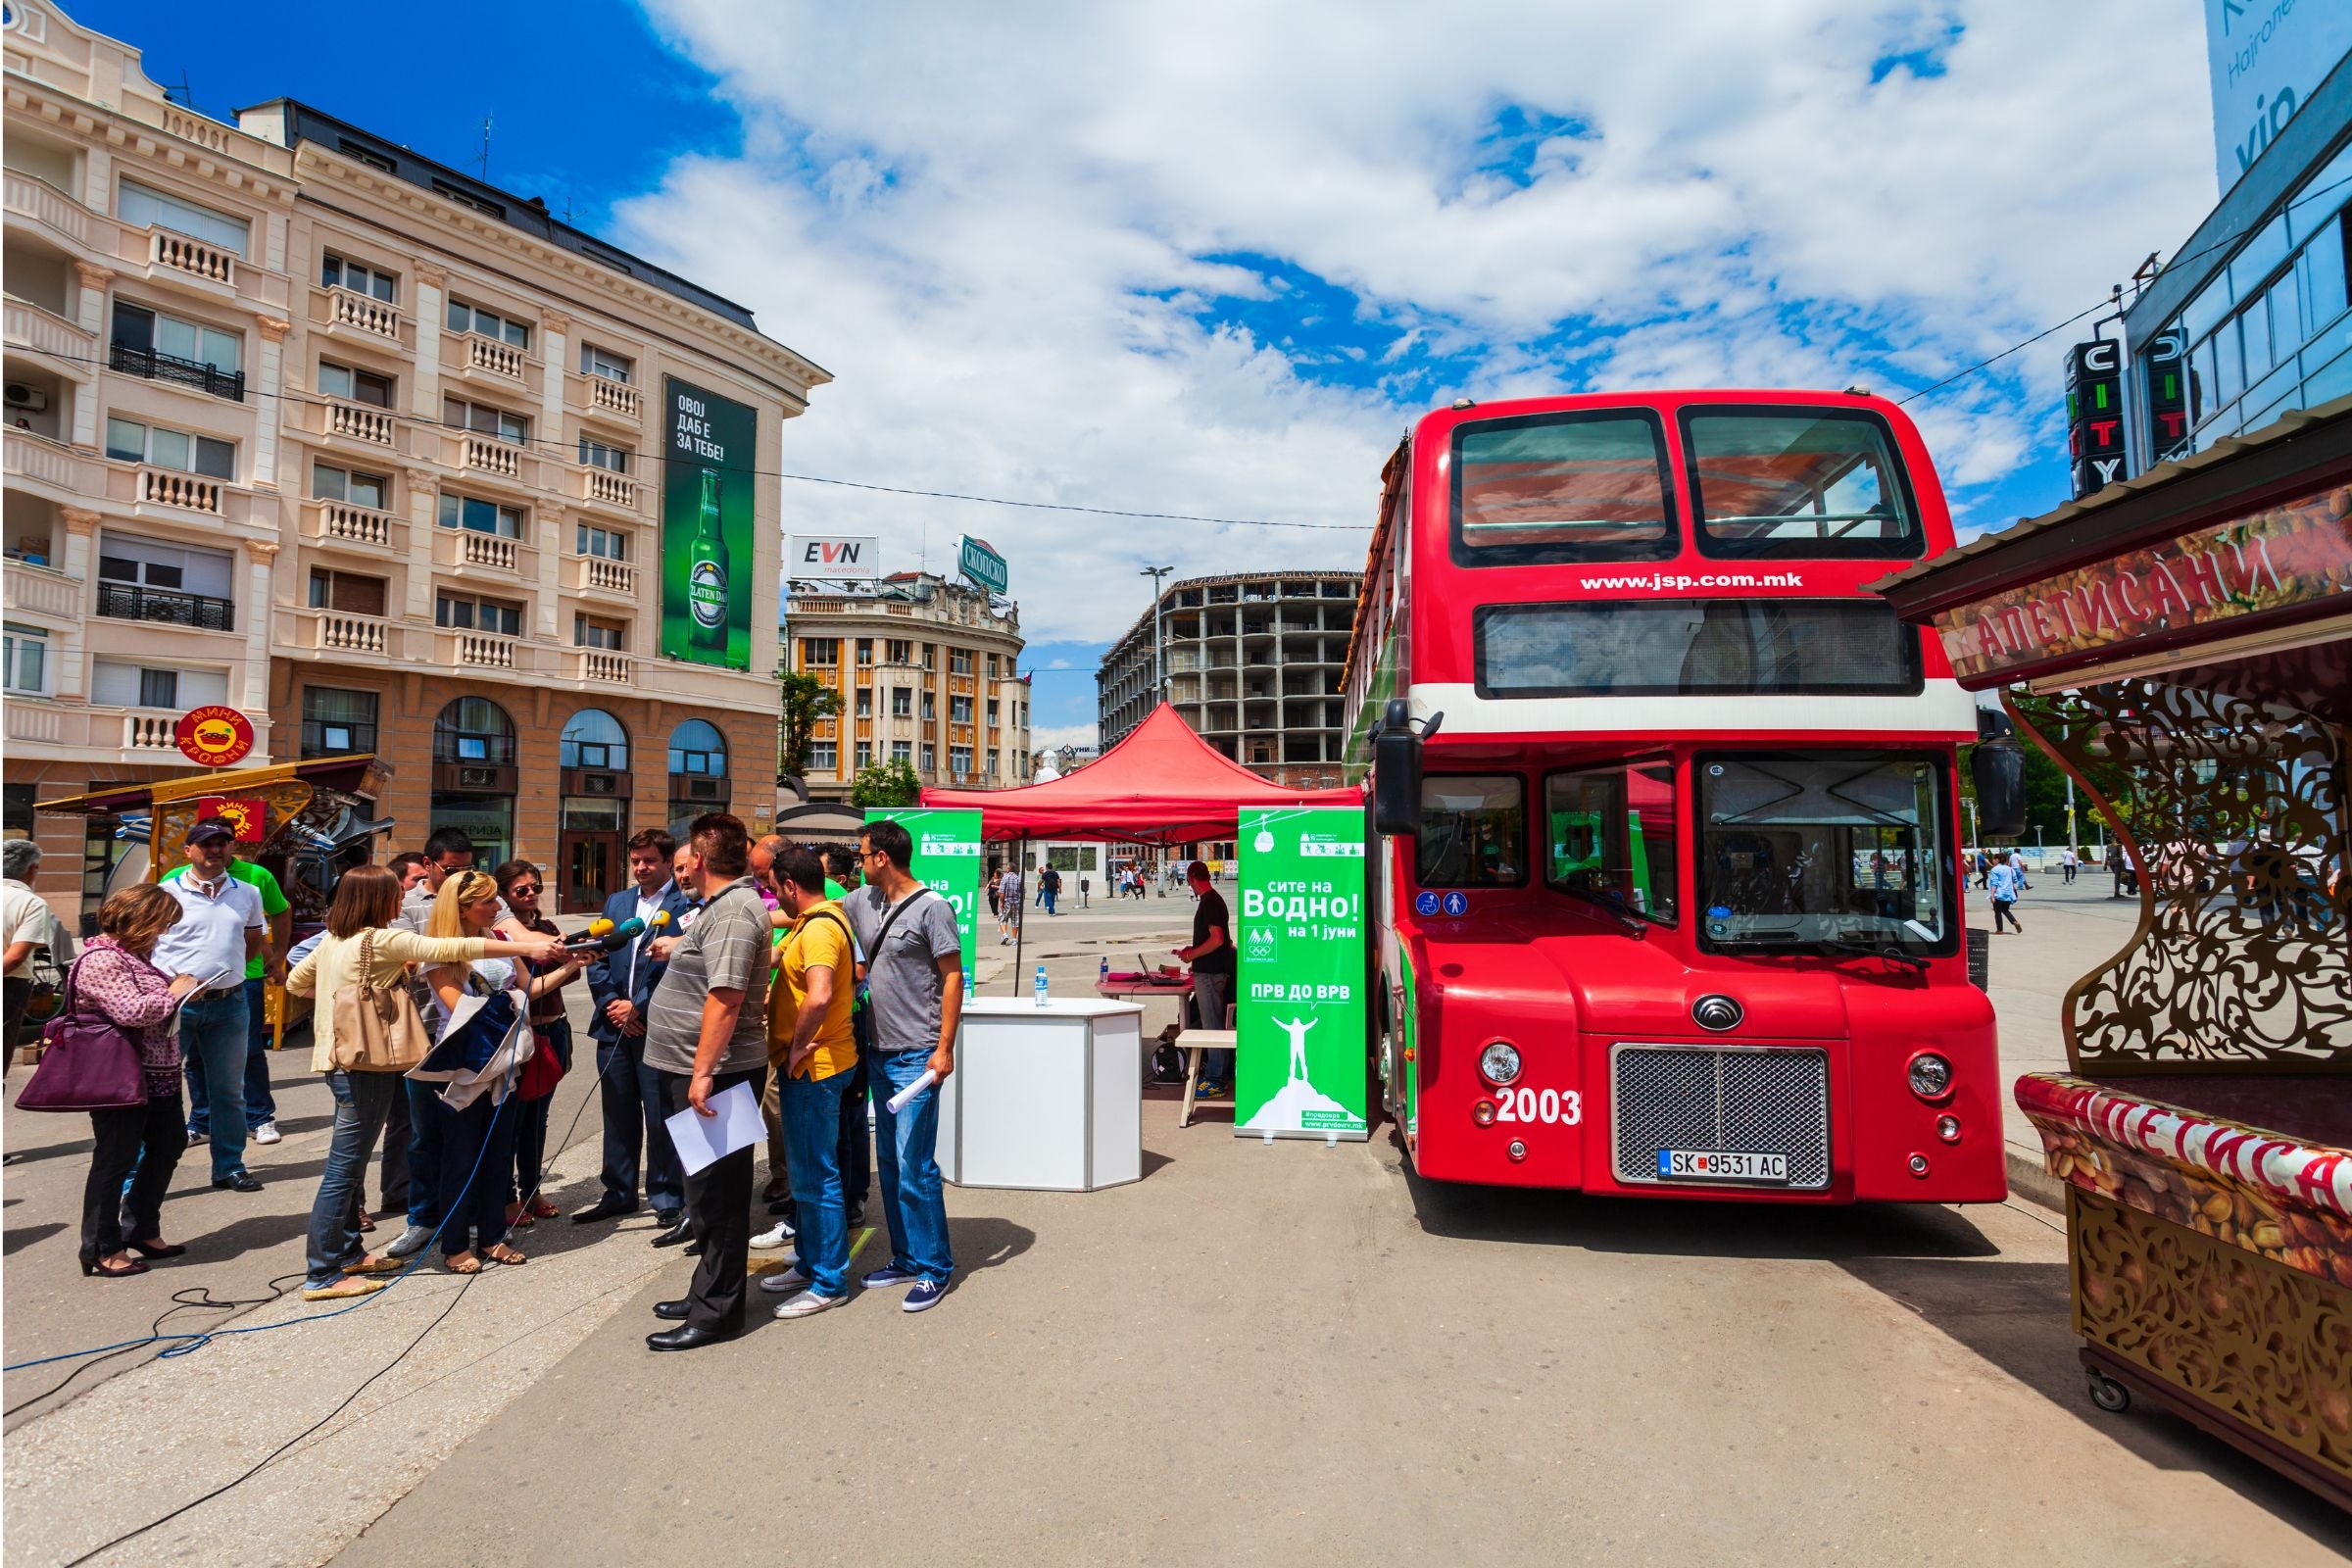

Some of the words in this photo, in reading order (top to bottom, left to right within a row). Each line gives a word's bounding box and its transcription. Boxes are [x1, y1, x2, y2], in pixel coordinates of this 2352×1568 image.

[678, 394, 705, 417] ОВОЈ
[2084, 344, 2122, 485] CITY
[677, 413, 702, 435] ДАБ
[704, 422, 711, 439] Е
[676, 432, 692, 451] ЗА
[694, 437, 724, 462] ТЕБЕ!
[805, 542, 860, 564] EVN
[964, 544, 1005, 586] СКОПСКО
[1580, 572, 1803, 591] www.jsp.com.mk
[1978, 534, 2282, 658] АПЕТИСАНИ
[190, 707, 244, 726] МИНИ
[179, 736, 250, 763] КРОФНИ
[216, 802, 251, 814] МИНИ
[1267, 881, 1306, 893] сите
[1311, 881, 1333, 893] на
[1244, 889, 1358, 922] Водно!
[1288, 926, 1306, 938] на
[1310, 924, 1318, 938] 1
[1322, 924, 1356, 941] јуни
[1251, 983, 1285, 998] ПРВ
[1288, 984, 1312, 1001] ДО
[1316, 984, 1350, 1000] ВРВ
[1495, 1087, 1581, 1126] 2003
[1672, 1153, 1695, 1173] SK
[1708, 1154, 1752, 1175] 9531
[1760, 1156, 1783, 1176] AC
[2070, 1090, 2352, 1219] АПЕТИСА
